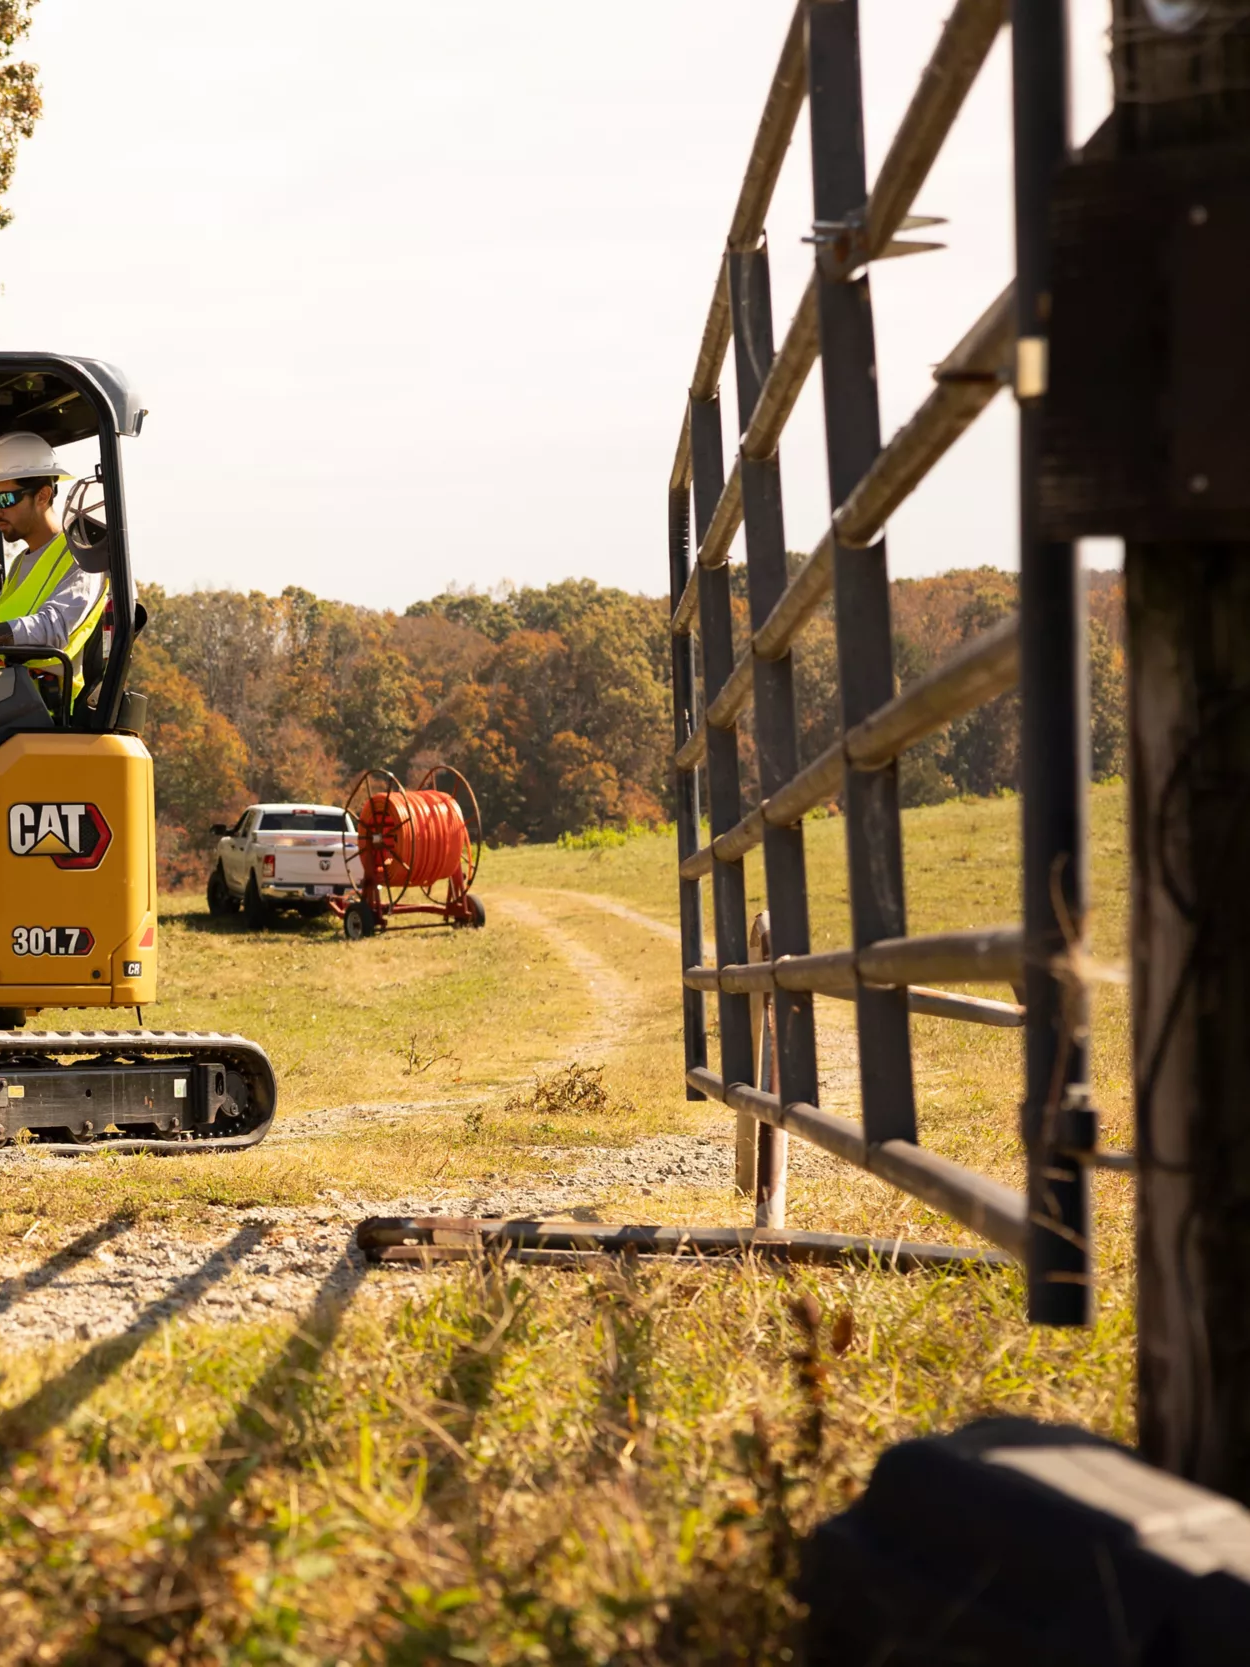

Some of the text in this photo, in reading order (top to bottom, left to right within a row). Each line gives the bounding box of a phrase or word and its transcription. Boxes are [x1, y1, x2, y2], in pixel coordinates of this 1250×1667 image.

[9, 803, 86, 855] CAT
[12, 926, 81, 955] 301.7
[127, 962, 141, 975] CR
